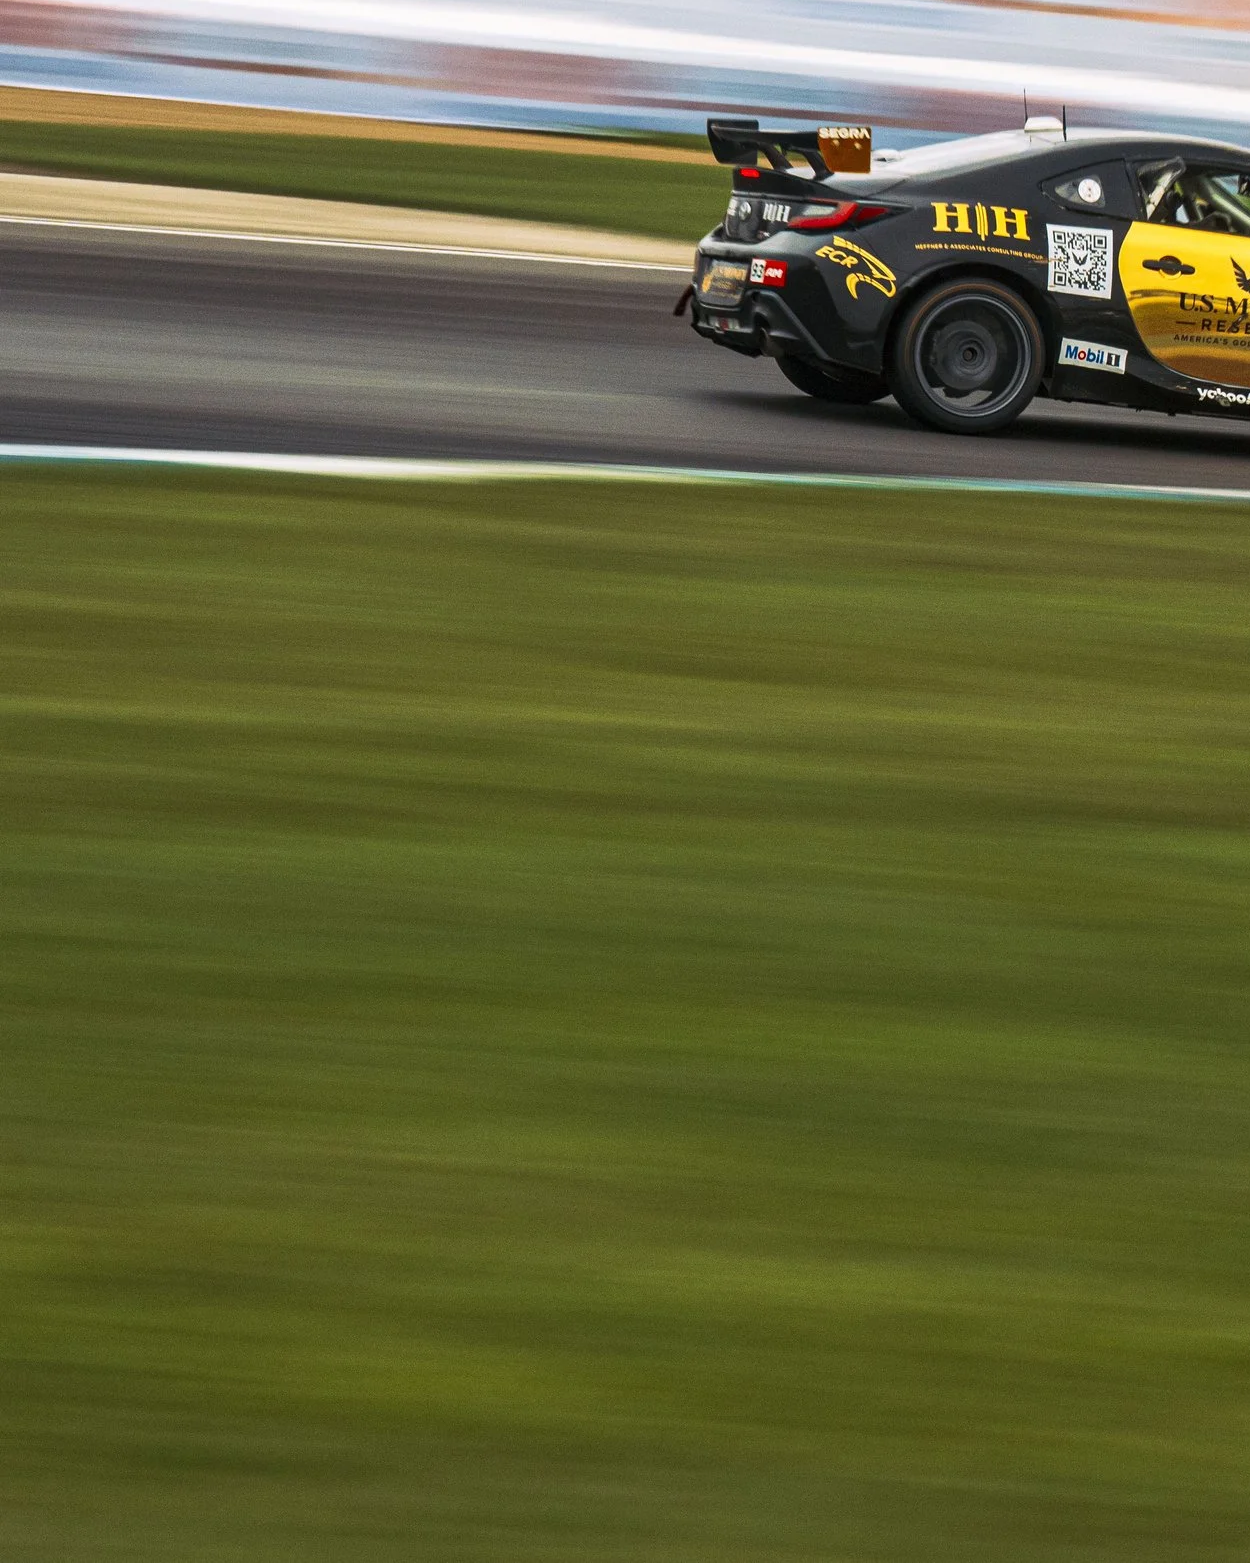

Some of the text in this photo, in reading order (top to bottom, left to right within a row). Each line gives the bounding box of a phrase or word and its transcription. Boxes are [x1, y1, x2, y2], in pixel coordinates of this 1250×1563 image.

[819, 127, 871, 140] SEGRA
[815, 246, 859, 269] ECR
[950, 244, 986, 253] ASSOCIATES
[987, 247, 1023, 258] CONSULTING
[1024, 251, 1043, 261] GROUP
[1178, 292, 1218, 314] U.S.
[1174, 334, 1228, 346] AMERICA'S
[1065, 345, 1104, 364] Mobil
